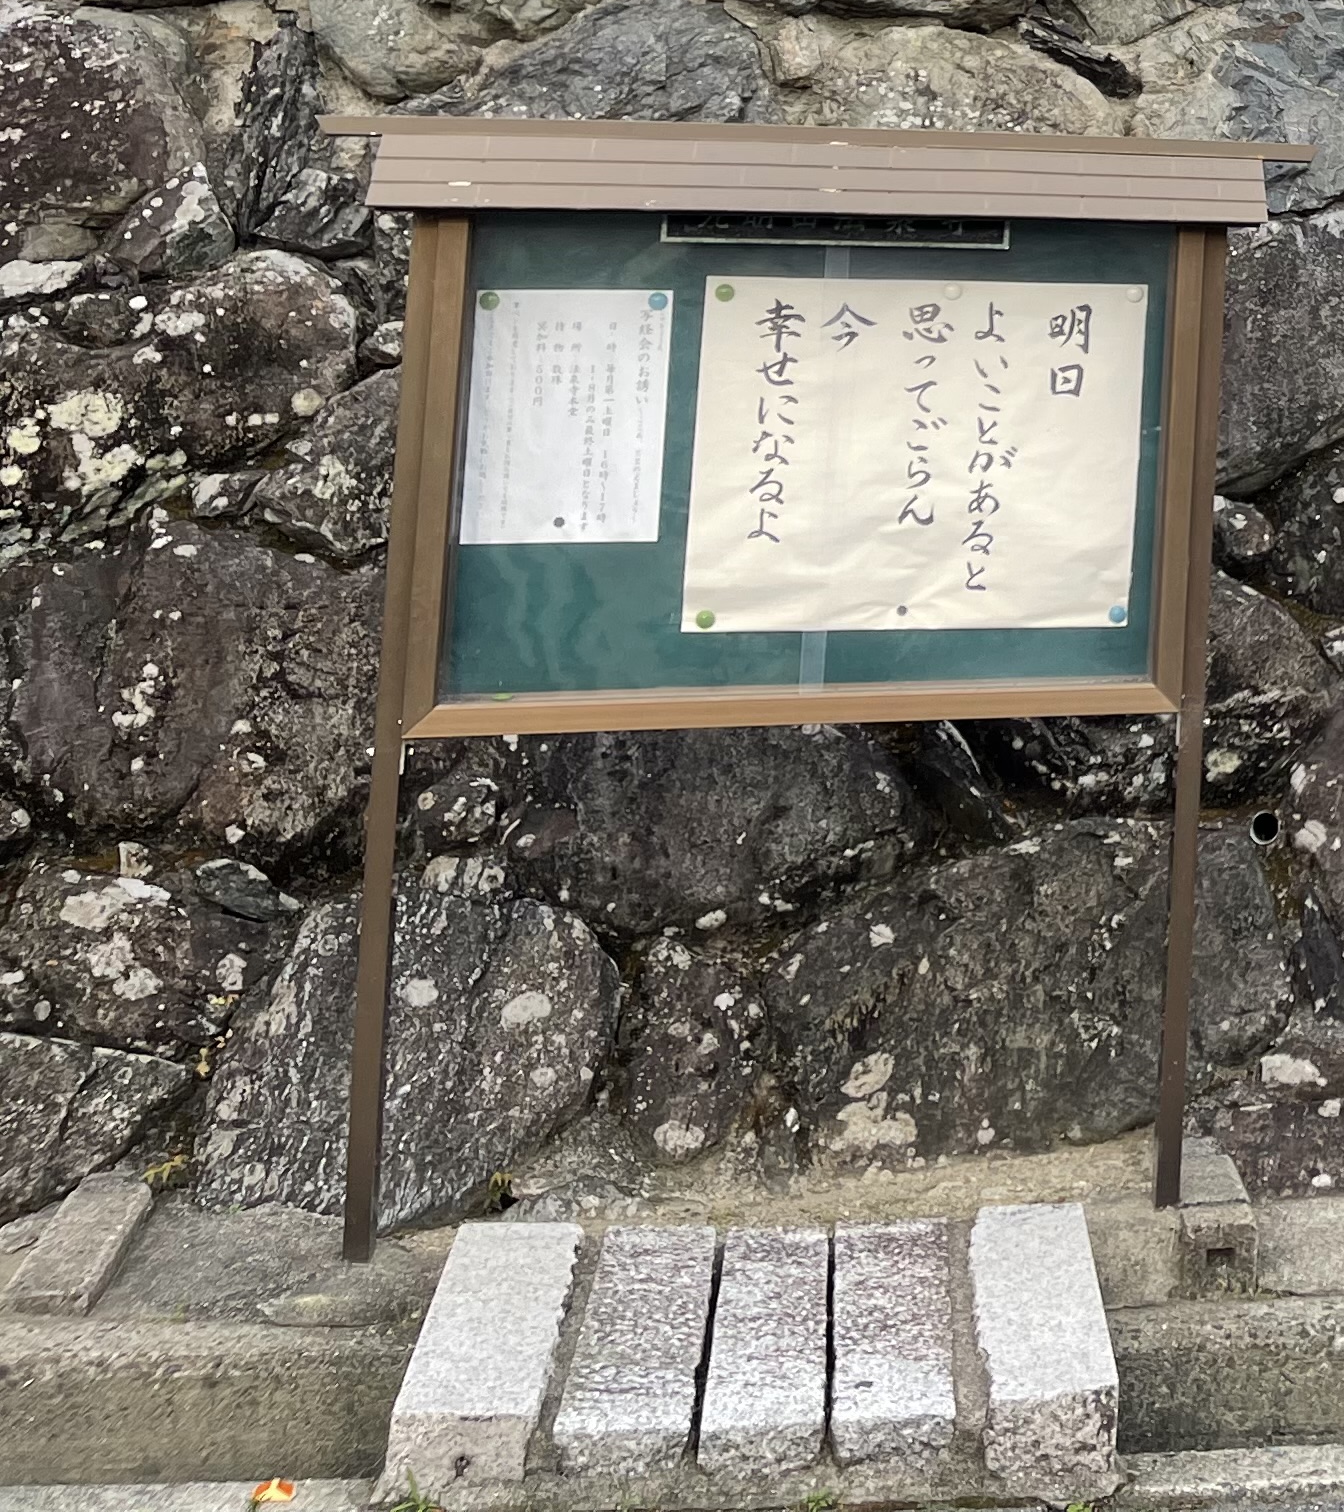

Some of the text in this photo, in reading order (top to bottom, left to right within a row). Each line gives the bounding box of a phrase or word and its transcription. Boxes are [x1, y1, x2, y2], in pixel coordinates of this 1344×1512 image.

[747, 298, 806, 543] 幸せになるよ
[821, 302, 878, 352] 今
[898, 303, 954, 526] 思ってごらん
[1047, 303, 1092, 397] 明日
[961, 301, 1018, 591] よいことがあると
